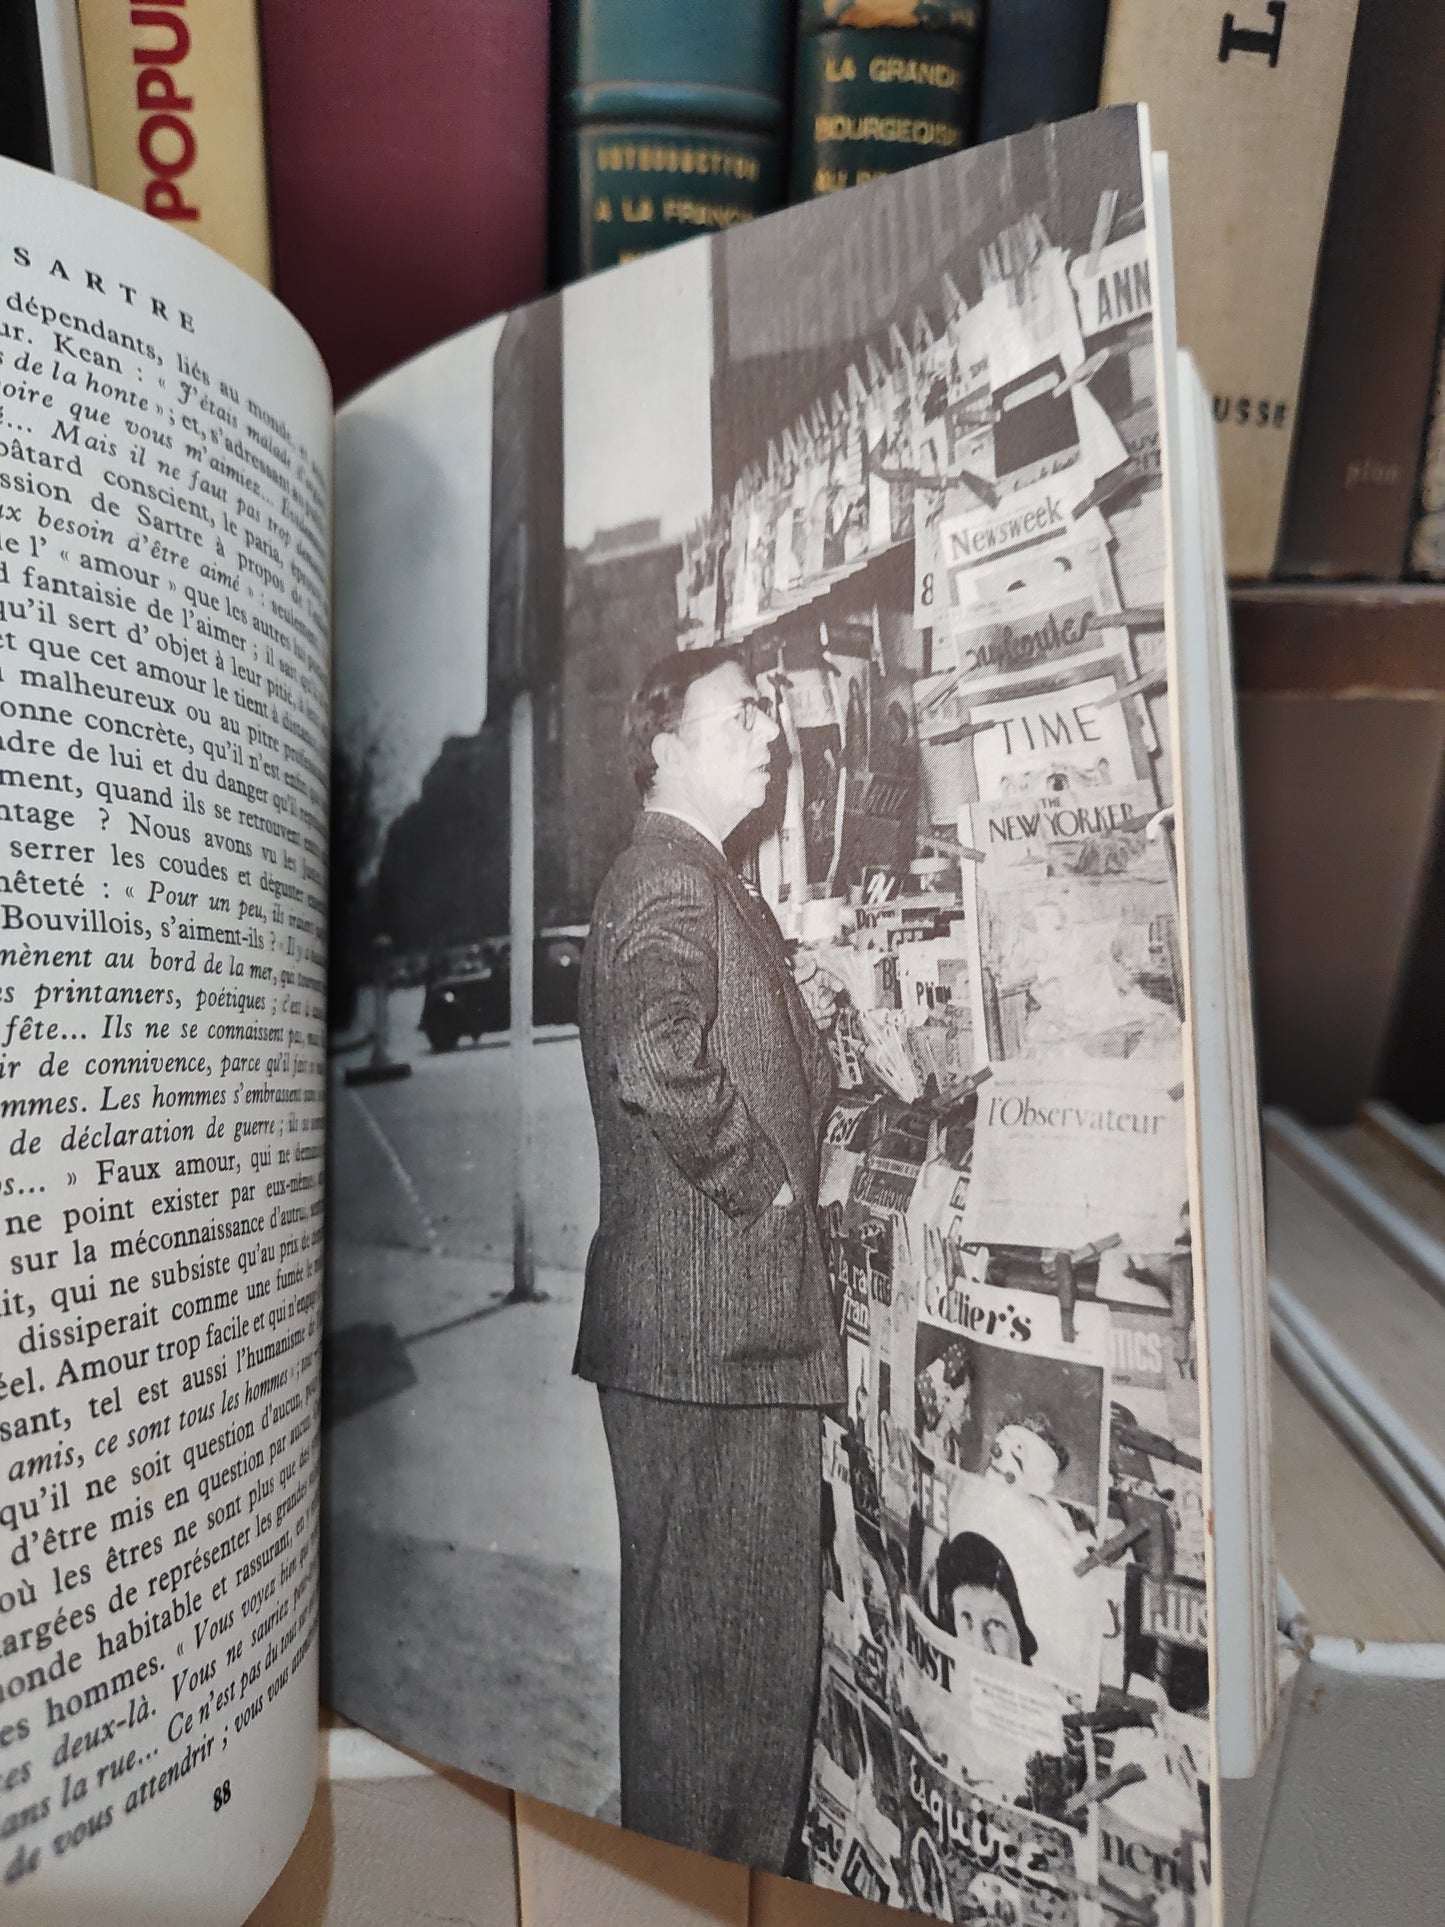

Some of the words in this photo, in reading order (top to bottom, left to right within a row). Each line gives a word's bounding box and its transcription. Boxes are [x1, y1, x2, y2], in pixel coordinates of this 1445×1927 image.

[826, 56, 857, 82] LA
[131, 0, 201, 222] POPU
[14, 246, 195, 333] SARTRE
[7, 292, 163, 365] dépendants,
[14, 352, 42, 376] de
[53, 362, 77, 386] la
[86, 374, 148, 411] honte
[53, 333, 122, 374] Kean
[181, 382, 238, 428] J'étais
[70, 402, 110, 426] que
[126, 420, 173, 449] vous
[51, 420, 117, 456] Mais
[159, 460, 180, 480] ne
[189, 470, 228, 501] faut
[92, 491, 120, 517] de
[137, 505, 203, 547] Sartre
[104, 469, 215, 528] conscient,
[949, 496, 1064, 561] Newsweek
[38, 507, 113, 545] besoin
[129, 533, 189, 570] d'être
[200, 562, 240, 592] aimé
[80, 553, 159, 591] amour
[185, 583, 219, 611] que
[23, 566, 136, 612] fantaisie
[148, 598, 174, 623] de
[183, 608, 247, 651] l'aimer
[30, 637, 80, 661] que
[91, 648, 127, 673] cet
[137, 660, 206, 695] amour
[69, 612, 117, 639] sert
[156, 633, 208, 666] objet
[232, 657, 262, 688] leur
[21, 667, 176, 715] malheureux
[187, 704, 211, 726] ou
[221, 713, 240, 736] au
[996, 700, 1103, 756] TIME
[68, 737, 99, 764] de
[111, 744, 143, 771] lui
[153, 758, 173, 777] et
[182, 761, 208, 785] du
[216, 770, 269, 805] danger
[85, 712, 194, 754] concrète,
[203, 737, 243, 767] qu'il
[97, 782, 173, 809] quand
[183, 791, 206, 815] ils
[215, 804, 231, 822] se
[130, 812, 191, 844] Nous
[205, 831, 252, 857] avons
[988, 811, 1040, 844] NEW
[10, 840, 95, 864] serrer
[112, 843, 145, 869] les
[159, 855, 228, 883] coudes
[1, 904, 151, 941] Bouvillois,
[161, 915, 264, 950] s'aiment-ils
[148, 881, 198, 908] Pour
[209, 894, 230, 913] un
[239, 900, 267, 924] peu,
[105, 950, 134, 969] au
[151, 947, 196, 973] bord
[204, 952, 222, 976] de
[229, 954, 244, 978] la
[250, 963, 277, 986] mer,
[196, 986, 266, 1012] poétiques
[2, 1014, 87, 1047] fête...
[102, 1014, 132, 1040] Ils
[146, 1022, 170, 1039] ne
[181, 1020, 197, 1039] se
[208, 1018, 284, 1043] connaissent
[39, 1052, 68, 1077] de
[86, 1050, 212, 1077] connivence,
[221, 1054, 260, 1079] parce
[100, 1085, 140, 1112] Les
[153, 1084, 226, 1110] hommes
[988, 1096, 1167, 1136] l'Observateur
[10, 1128, 41, 1157] de
[61, 1117, 194, 1153] déclaration
[206, 1115, 225, 1139] de
[234, 1117, 275, 1144] guerre
[97, 1158, 161, 1186] Faux
[175, 1151, 241, 1178] amour,
[6, 1211, 42, 1236] ne
[63, 1197, 134, 1235] point
[152, 1188, 219, 1217] exister
[231, 1182, 255, 1210] par
[11, 1248, 58, 1275] sur
[73, 1238, 97, 1267] la
[110, 1210, 264, 1260] méconnaissance
[51, 1274, 97, 1314] qui
[110, 1274, 140, 1298] ne
[152, 1253, 230, 1290] subsiste
[237, 1242, 275, 1271] qu'au
[19, 1302, 159, 1355] dissiperait
[172, 1285, 239, 1321] comme
[247, 1277, 271, 1301] une
[56, 1347, 150, 1388] Amour
[157, 1333, 201, 1363] trop
[206, 1313, 249, 1350] facile
[89, 1386, 122, 1419] tel
[138, 1377, 169, 1405] est
[182, 1354, 228, 1393] aussi
[237, 1326, 306, 1374] l'humanisme
[8, 1439, 85, 1483] amis,
[95, 1433, 118, 1458] ce
[127, 1415, 171, 1450] sont
[179, 1402, 216, 1431] tous
[85, 1471, 117, 1502] ne
[131, 1451, 170, 1486] soit
[182, 1421, 255, 1469] question
[10, 1523, 98, 1568] d'être
[110, 1501, 154, 1535] mis
[165, 1486, 189, 1512] en
[198, 1451, 264, 1502] question
[54, 1561, 91, 1596] les
[105, 1533, 163, 1575] êtres
[173, 1521, 198, 1548] ne
[207, 1498, 242, 1531] sont
[248, 1475, 275, 1511] plus
[98, 1593, 203, 1661] habitable
[236, 1533, 293, 1588] rassurant,
[148, 1529, 251, 1600] représenter
[45, 1652, 166, 1730] hommes.
[193, 1605, 234, 1650] Vous
[242, 1576, 275, 1621] voyez
[53, 1687, 156, 1771] deux-là.
[172, 1656, 216, 1701] Vous
[251, 1601, 289, 1650] sauriez
[62, 1774, 89, 1810] la
[98, 1745, 159, 1789] rue...
[168, 1710, 193, 1745] Ce
[198, 1676, 235, 1726] n'est
[53, 1801, 113, 1859] vous
[125, 1733, 215, 1816] attendrir
[235, 1696, 263, 1735] vous
[213, 1779, 231, 1813] 88
